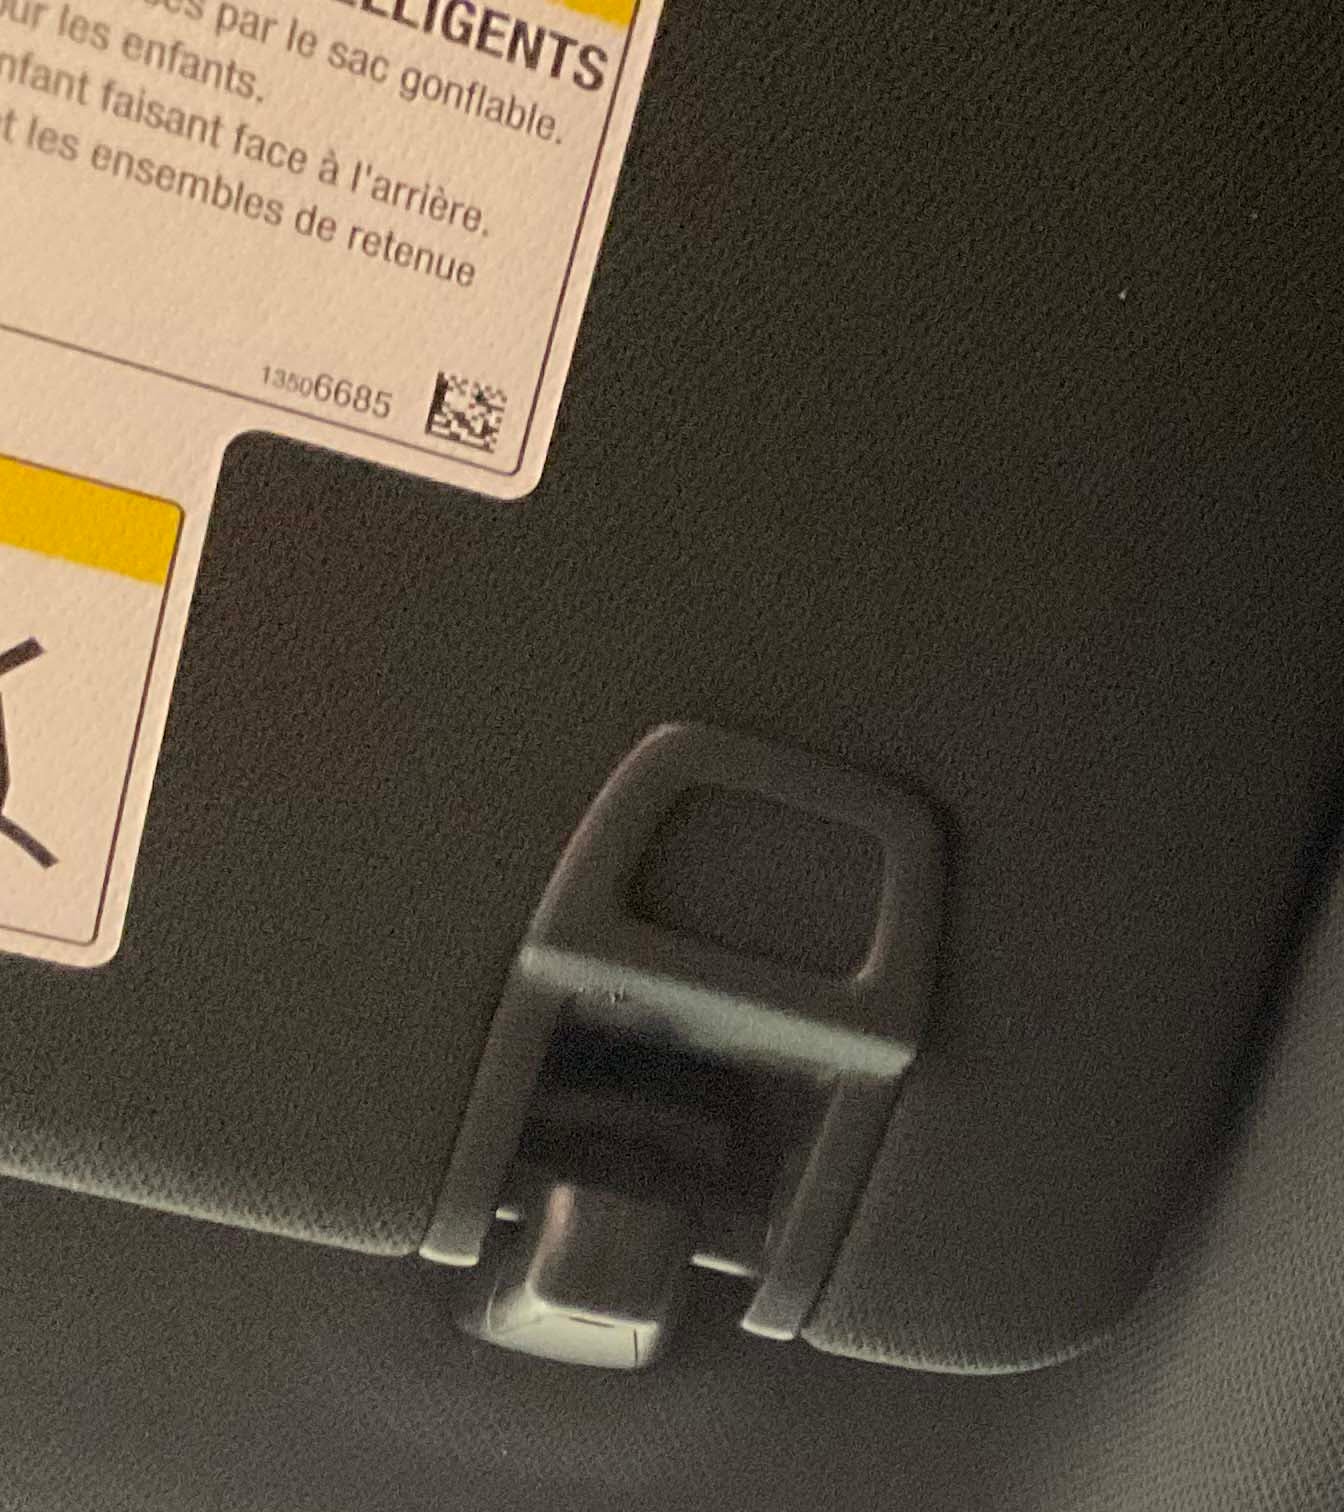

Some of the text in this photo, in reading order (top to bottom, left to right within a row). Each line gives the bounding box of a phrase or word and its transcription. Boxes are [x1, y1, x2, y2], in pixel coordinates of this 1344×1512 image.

[58, 3, 111, 52] les
[121, 31, 263, 103] enfants.
[215, 2, 278, 44] par
[286, 17, 318, 58] le
[327, 39, 390, 83] sac
[399, 66, 562, 145] gonflable.
[334, 0, 609, 92] LIGENTS
[26, 115, 80, 161] les
[90, 143, 284, 226] ensembles
[294, 204, 337, 243] de
[347, 225, 476, 288] retenue
[100, 79, 223, 149] faisant
[232, 123, 308, 175] face
[318, 148, 340, 186] à
[351, 160, 489, 238] l'arrière.
